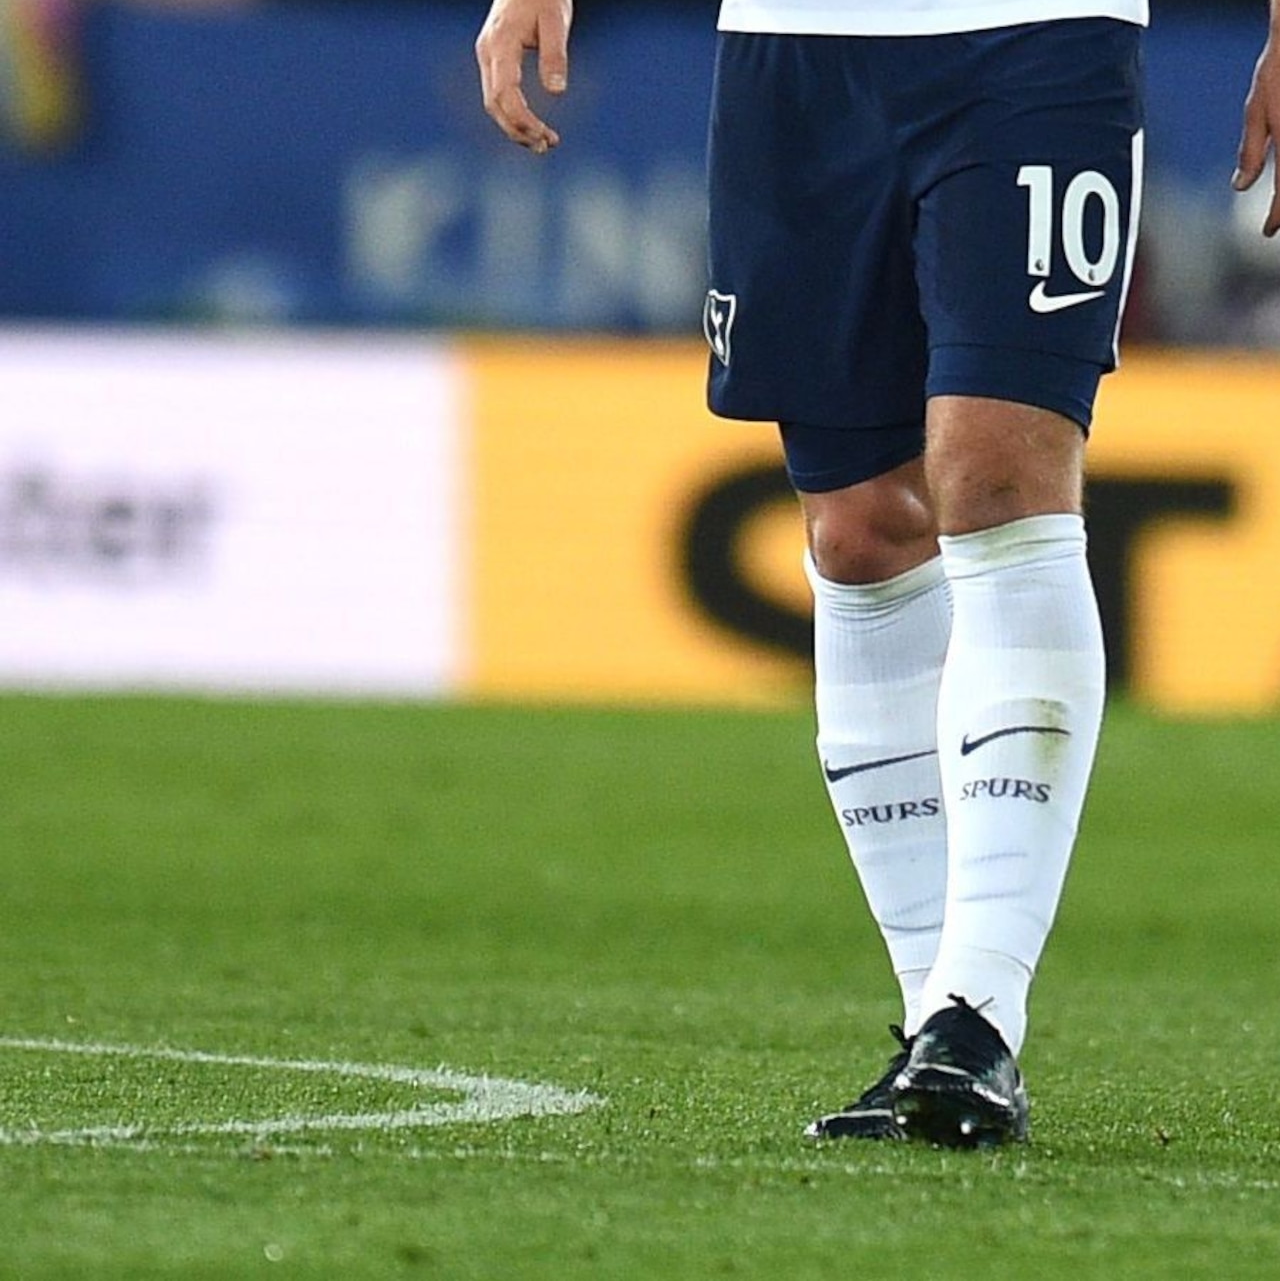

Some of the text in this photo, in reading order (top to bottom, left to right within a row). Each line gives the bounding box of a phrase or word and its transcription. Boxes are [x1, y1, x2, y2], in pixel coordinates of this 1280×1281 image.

[1016, 165, 1120, 286] 10
[958, 777, 1052, 803] SPURS
[842, 797, 939, 827] SPURS
